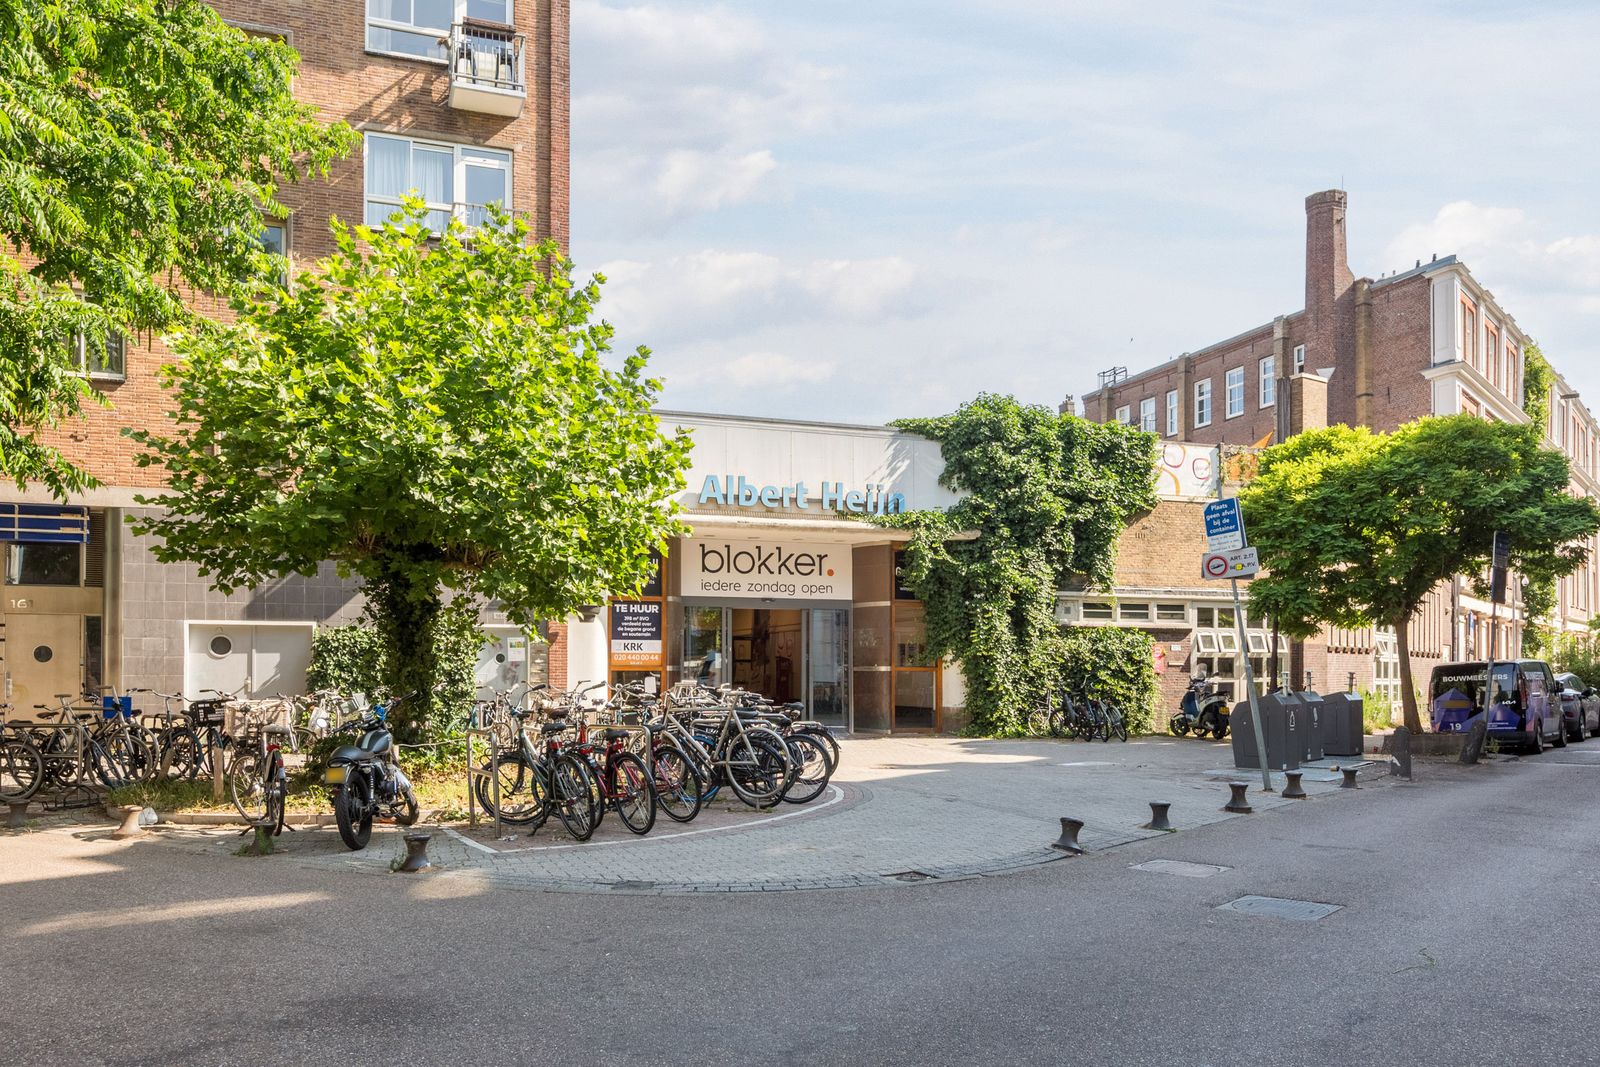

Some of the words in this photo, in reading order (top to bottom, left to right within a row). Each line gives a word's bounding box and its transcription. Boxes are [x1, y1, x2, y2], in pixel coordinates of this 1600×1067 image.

[699, 474, 808, 509] Albert
[822, 481, 906, 516] Heijn
[1206, 513, 1220, 521] geen
[1210, 525, 1236, 534] container
[700, 579, 741, 592] iedere
[747, 581, 796, 595] zondag
[802, 583, 834, 596] open
[614, 604, 628, 613] TE
[629, 604, 659, 613] HUUR
[623, 642, 643, 651] KRK
[1442, 674, 1508, 682] BOUWMEESERS
